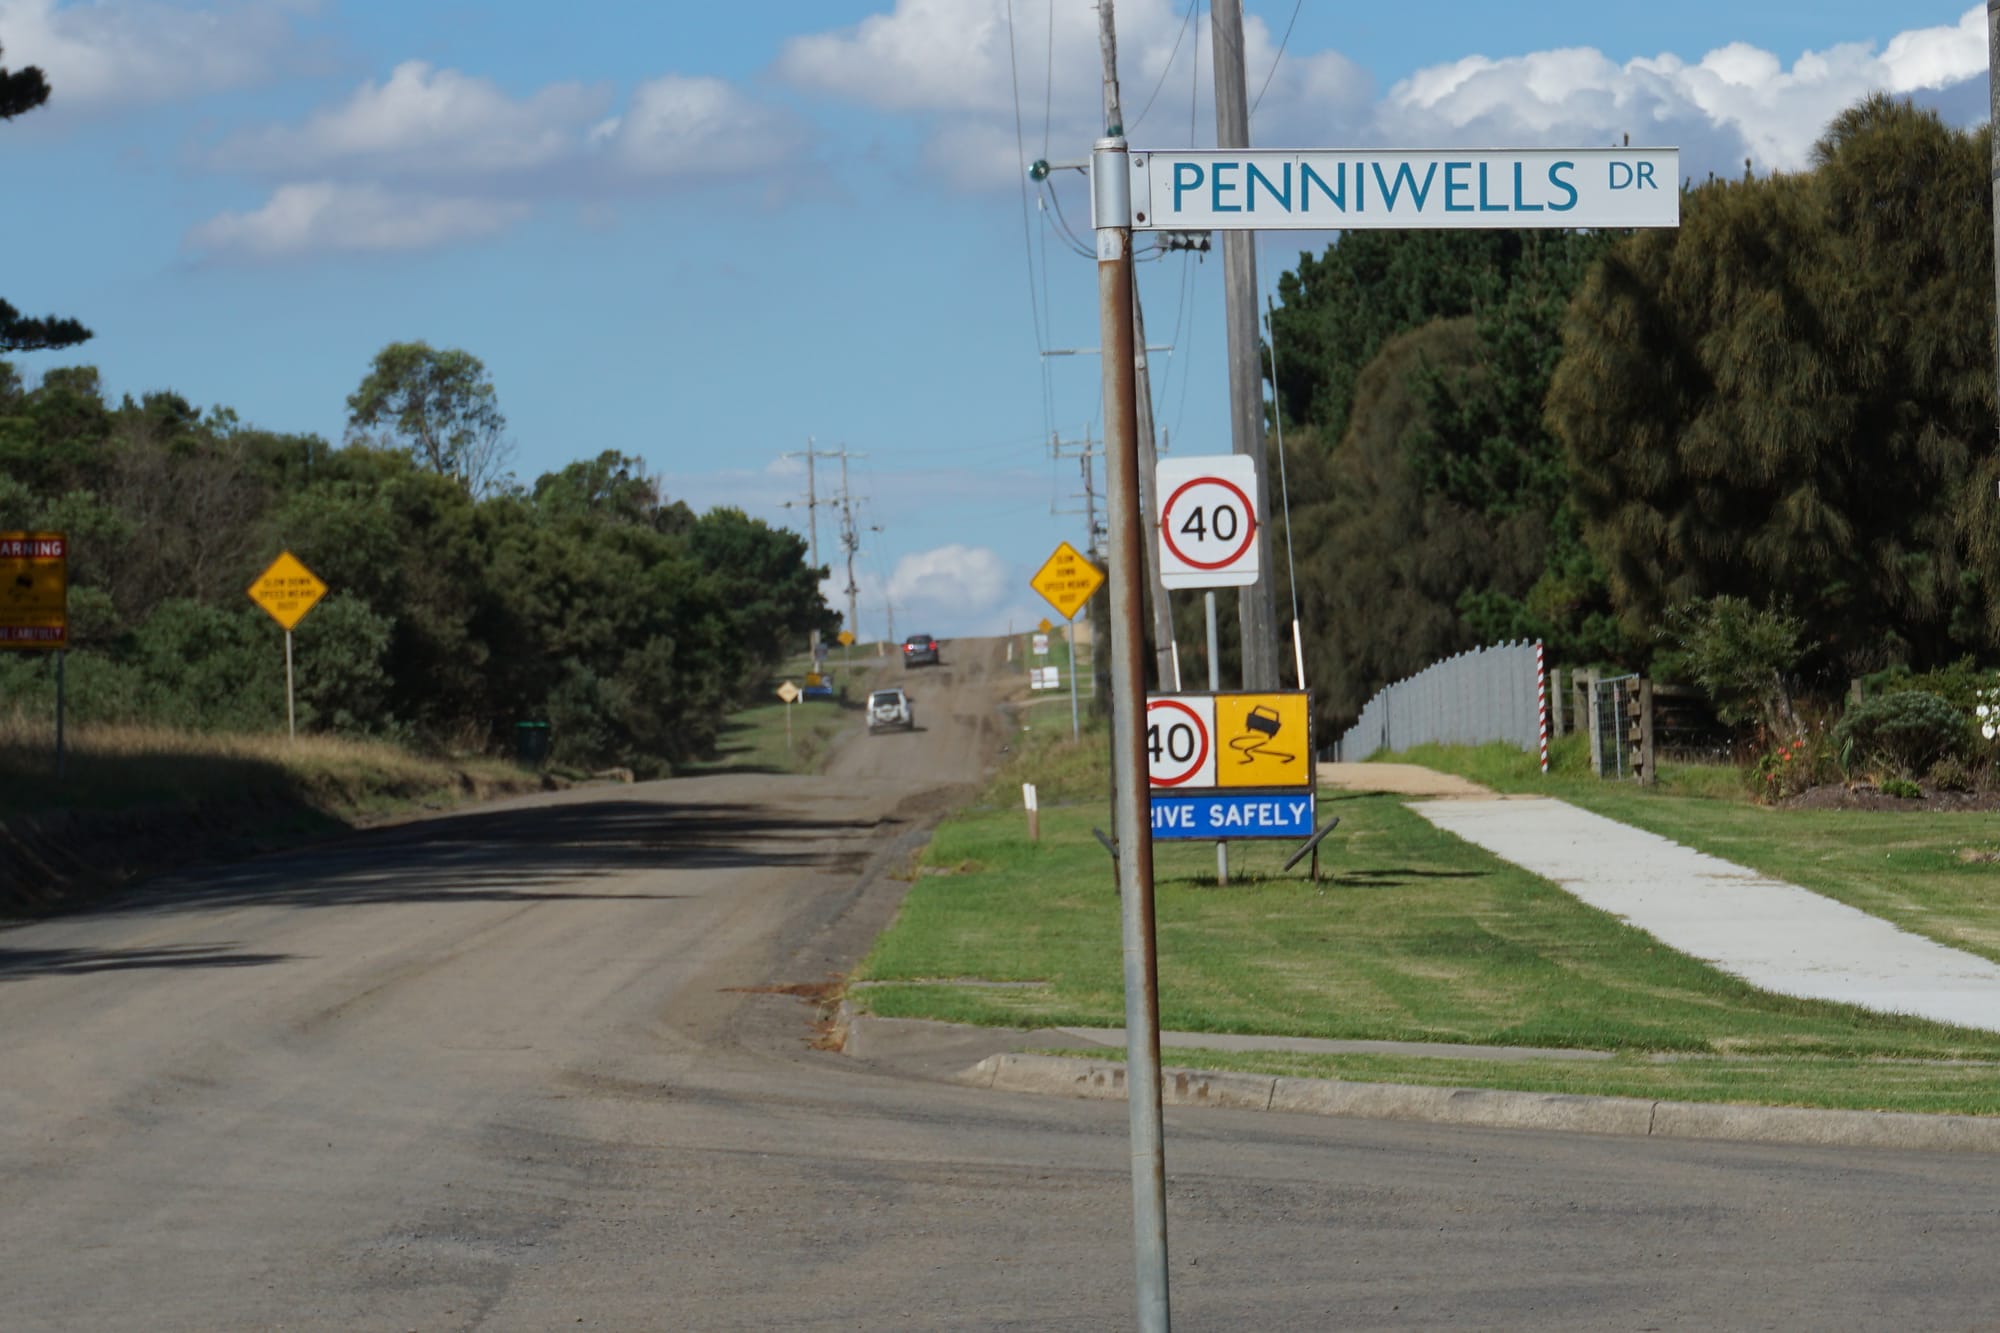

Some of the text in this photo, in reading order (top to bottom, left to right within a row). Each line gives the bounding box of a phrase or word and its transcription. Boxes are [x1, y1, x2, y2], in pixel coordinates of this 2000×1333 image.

[1173, 161, 1659, 213] PENNIWELLS DR
[1181, 504, 1238, 543] 40
[1147, 723, 1195, 763] 40
[1151, 802, 1306, 828] IVE SAFELY
